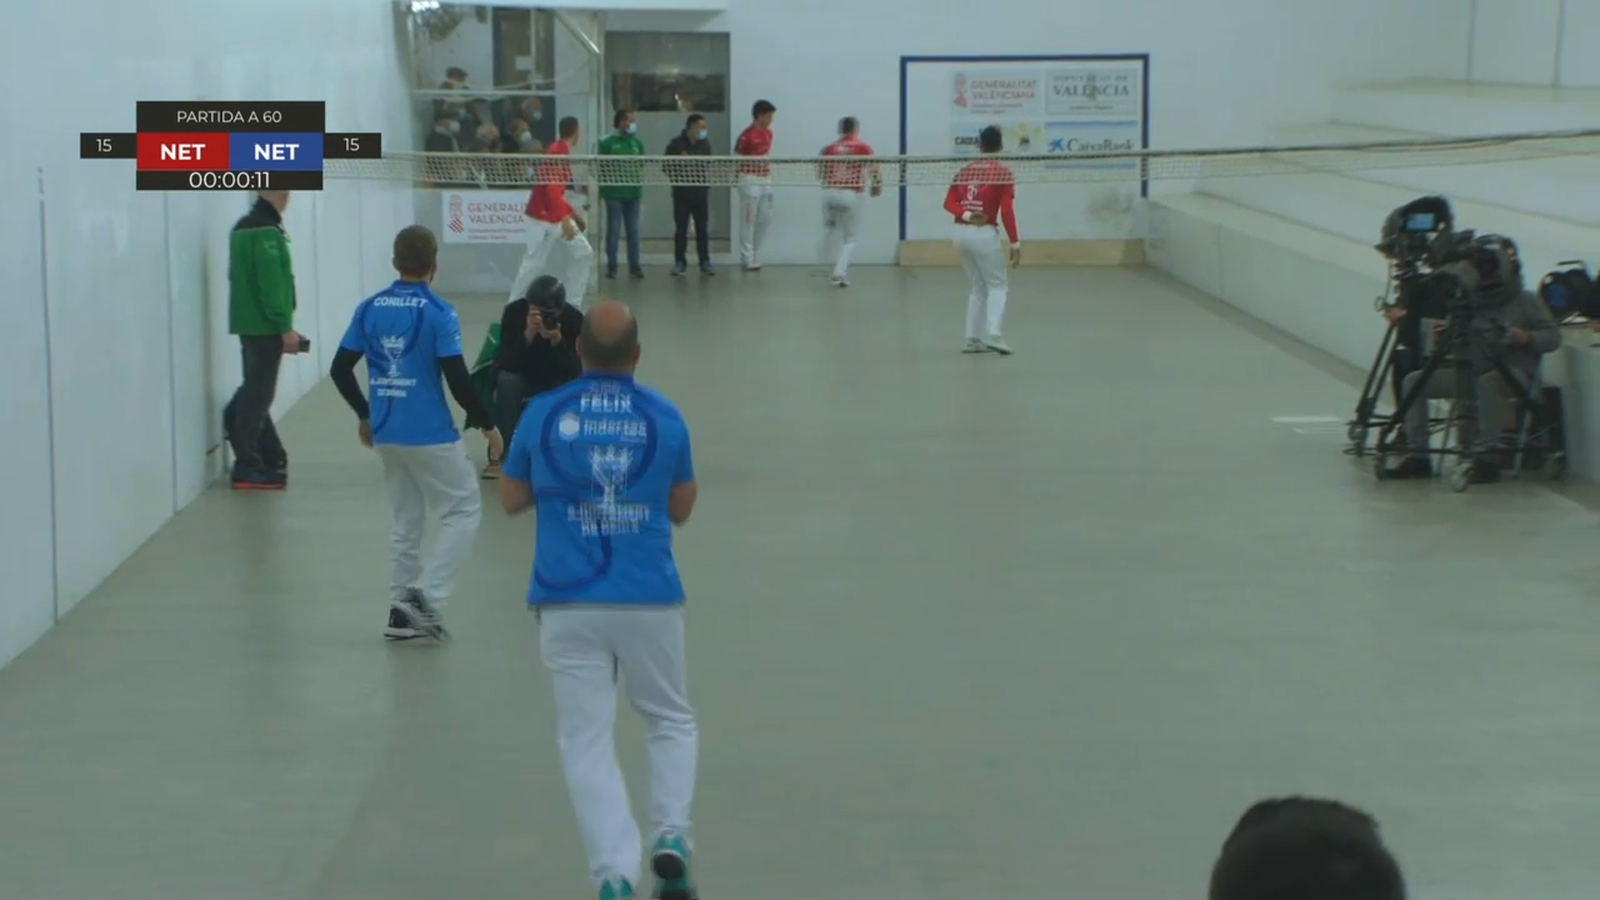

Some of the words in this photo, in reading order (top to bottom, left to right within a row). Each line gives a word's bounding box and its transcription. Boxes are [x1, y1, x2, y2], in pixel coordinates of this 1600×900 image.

[971, 79, 1038, 90] GENERALITAT
[973, 89, 1037, 101] VALENCIANA
[1067, 138, 1135, 152] CaixaBank
[469, 214, 525, 224] VALENCIA
[373, 296, 429, 308] CONILLET
